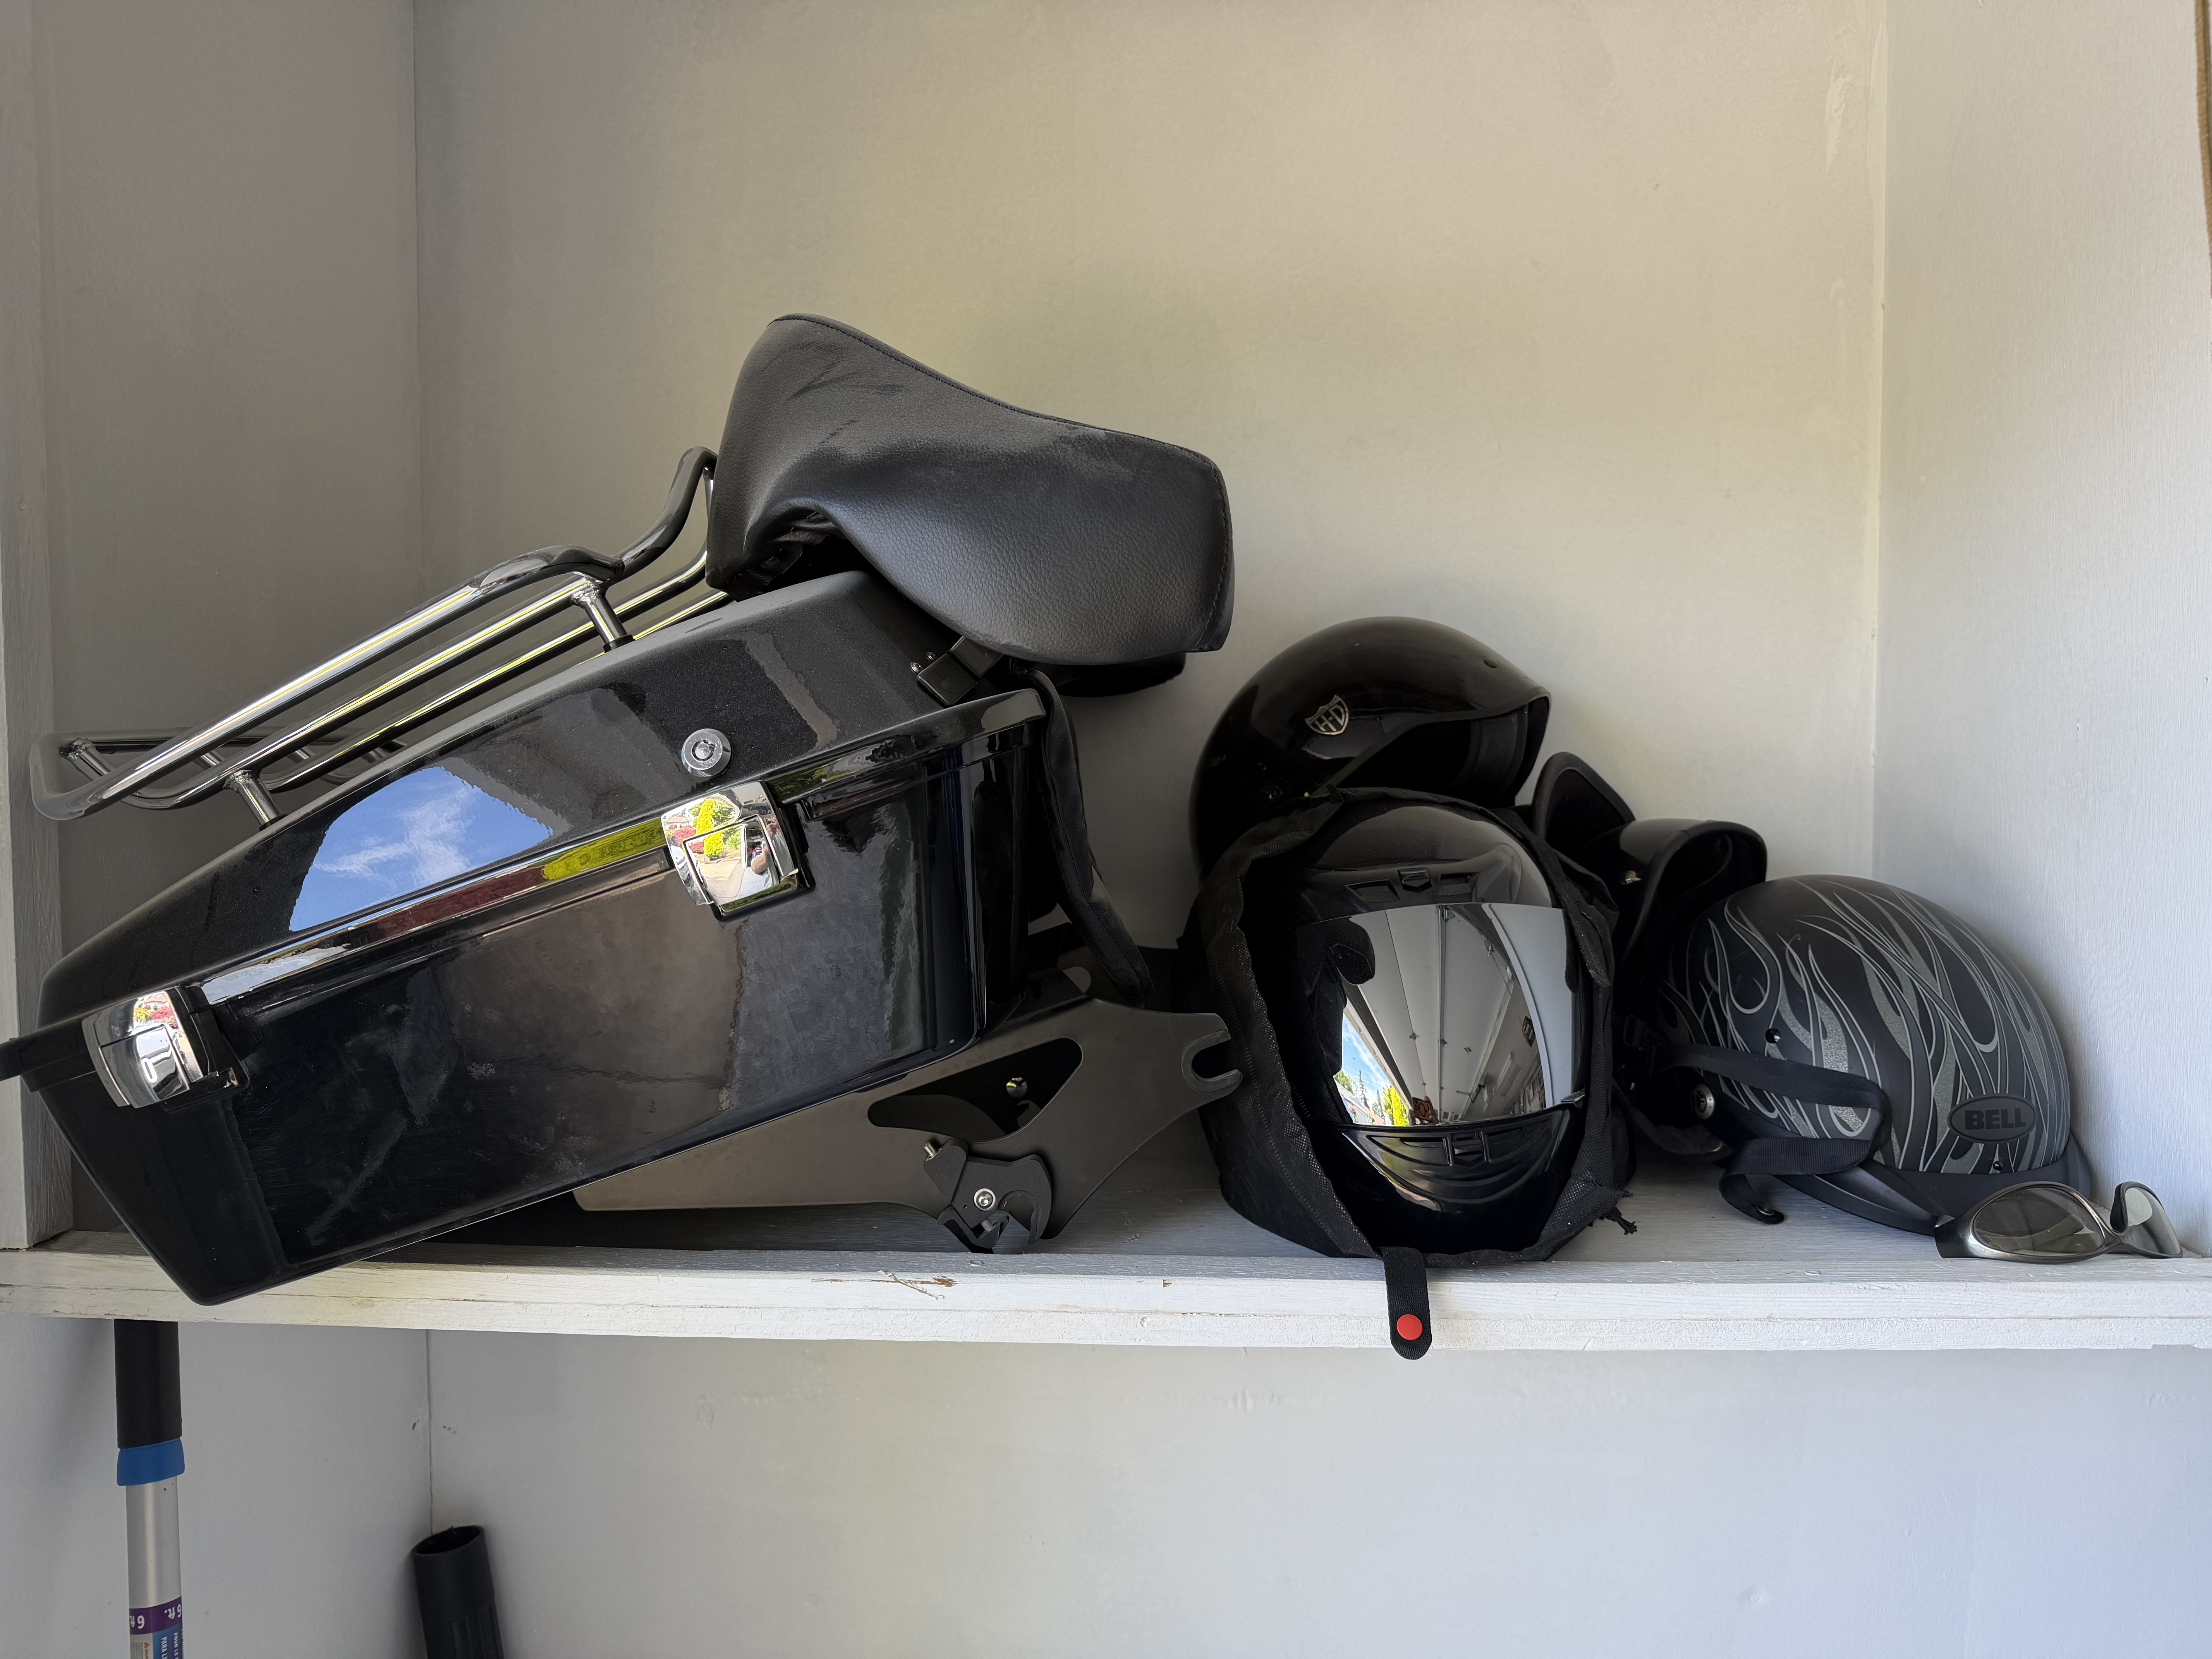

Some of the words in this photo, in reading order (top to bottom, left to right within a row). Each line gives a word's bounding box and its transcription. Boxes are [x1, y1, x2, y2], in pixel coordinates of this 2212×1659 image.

[1314, 704, 1345, 732] H-D
[1965, 1108, 2027, 1130] BELL
[164, 1606, 175, 1619] ft.
[177, 1604, 181, 1618] 6
[137, 1615, 145, 1629] 6
